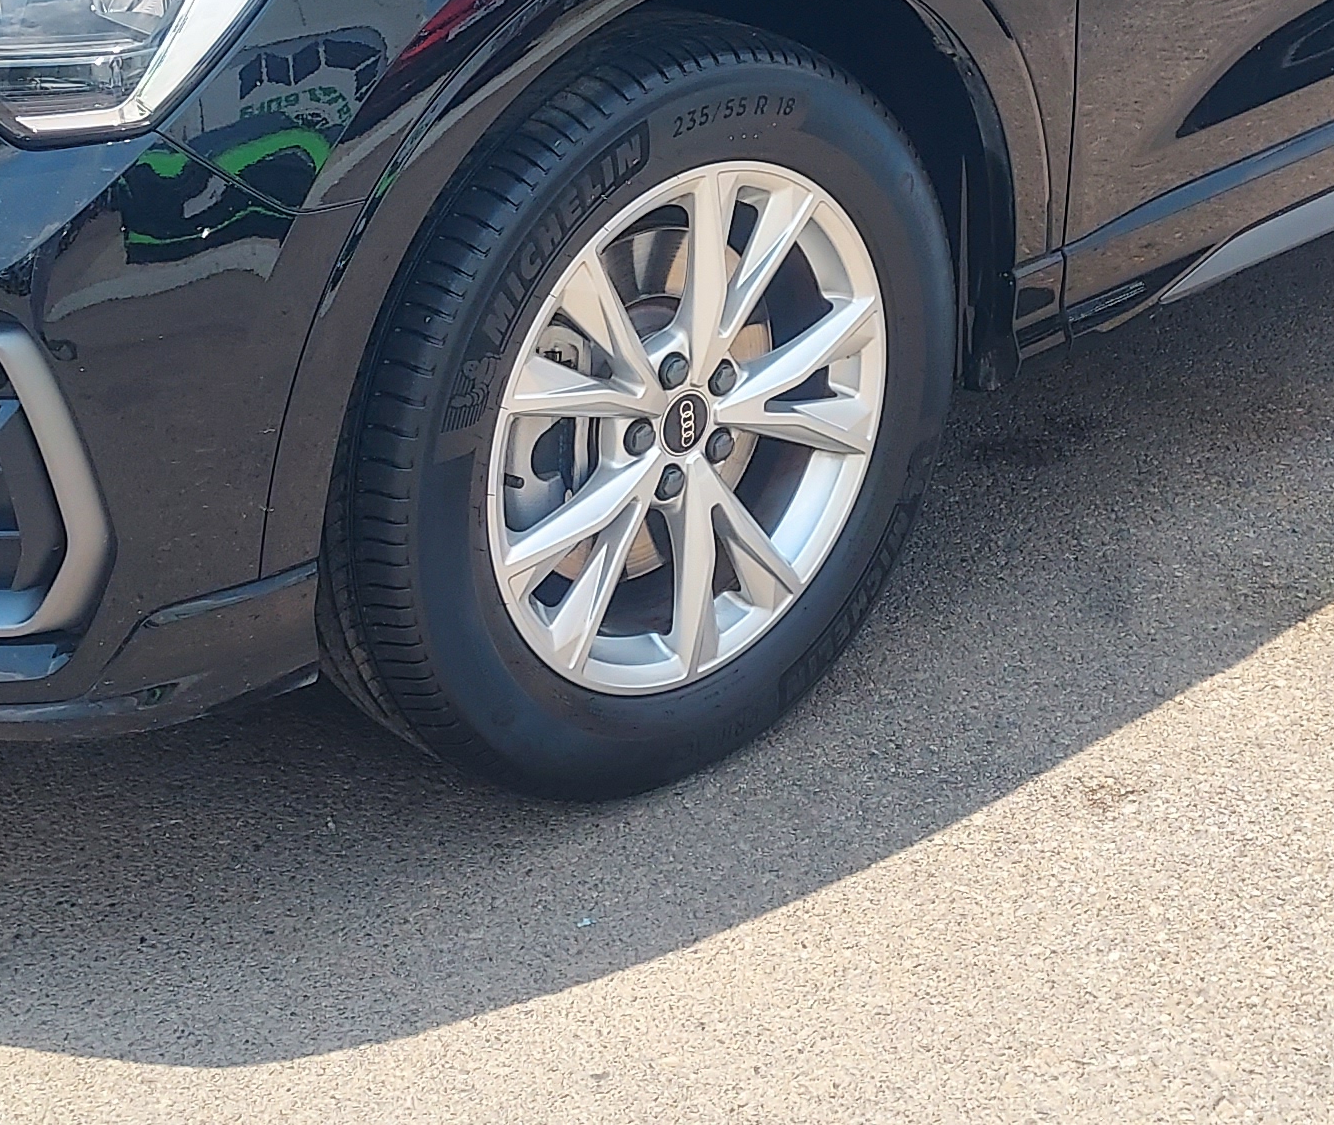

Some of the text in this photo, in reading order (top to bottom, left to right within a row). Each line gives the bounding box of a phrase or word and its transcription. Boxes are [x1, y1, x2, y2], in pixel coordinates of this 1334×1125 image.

[672, 95, 796, 138] 235/55 R 18
[483, 132, 643, 346] MICHELIN
